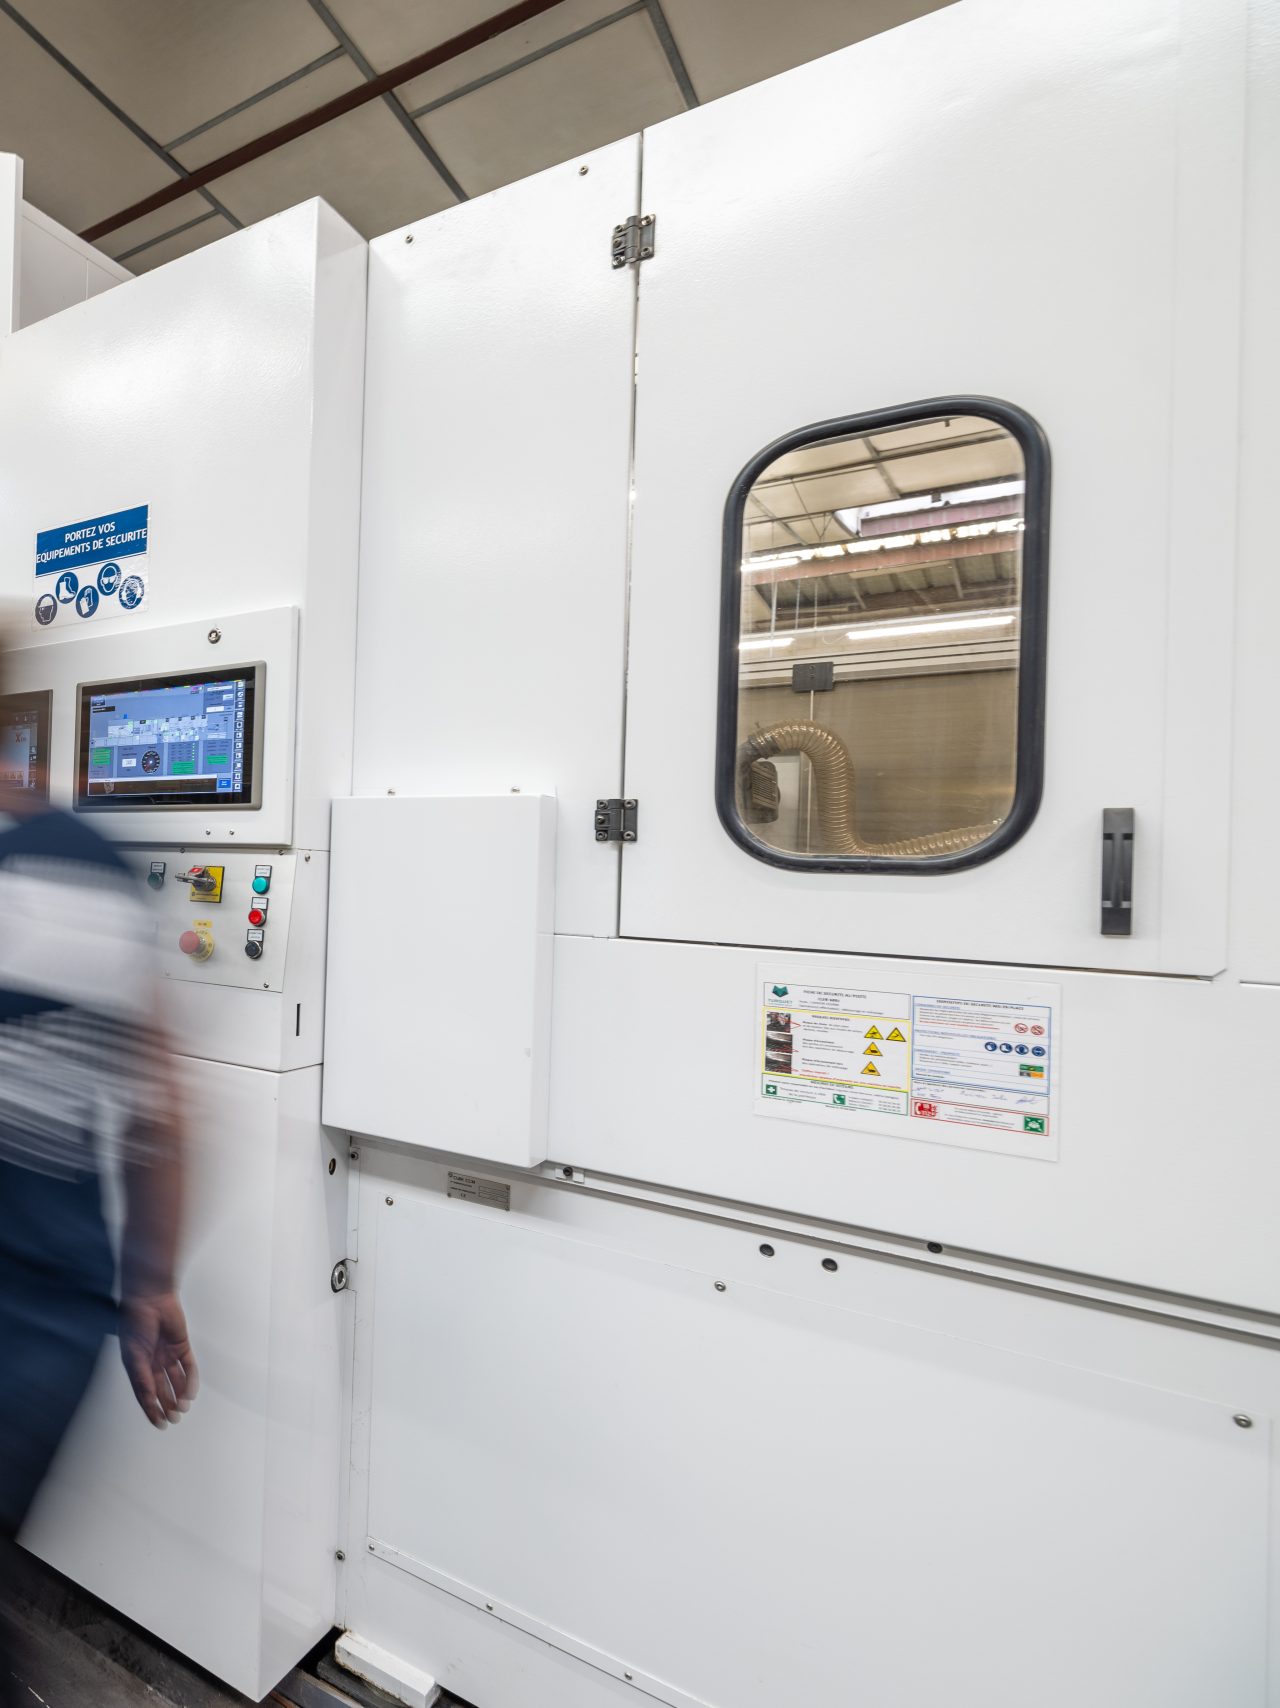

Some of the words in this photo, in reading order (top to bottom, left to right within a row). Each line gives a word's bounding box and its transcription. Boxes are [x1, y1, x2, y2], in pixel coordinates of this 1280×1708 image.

[36, 542, 91, 563] EQUIPEMENTS
[92, 538, 104, 550] DE
[105, 528, 148, 547] SECURITE
[64, 525, 96, 544] PORTEZ
[98, 521, 116, 535] VOS
